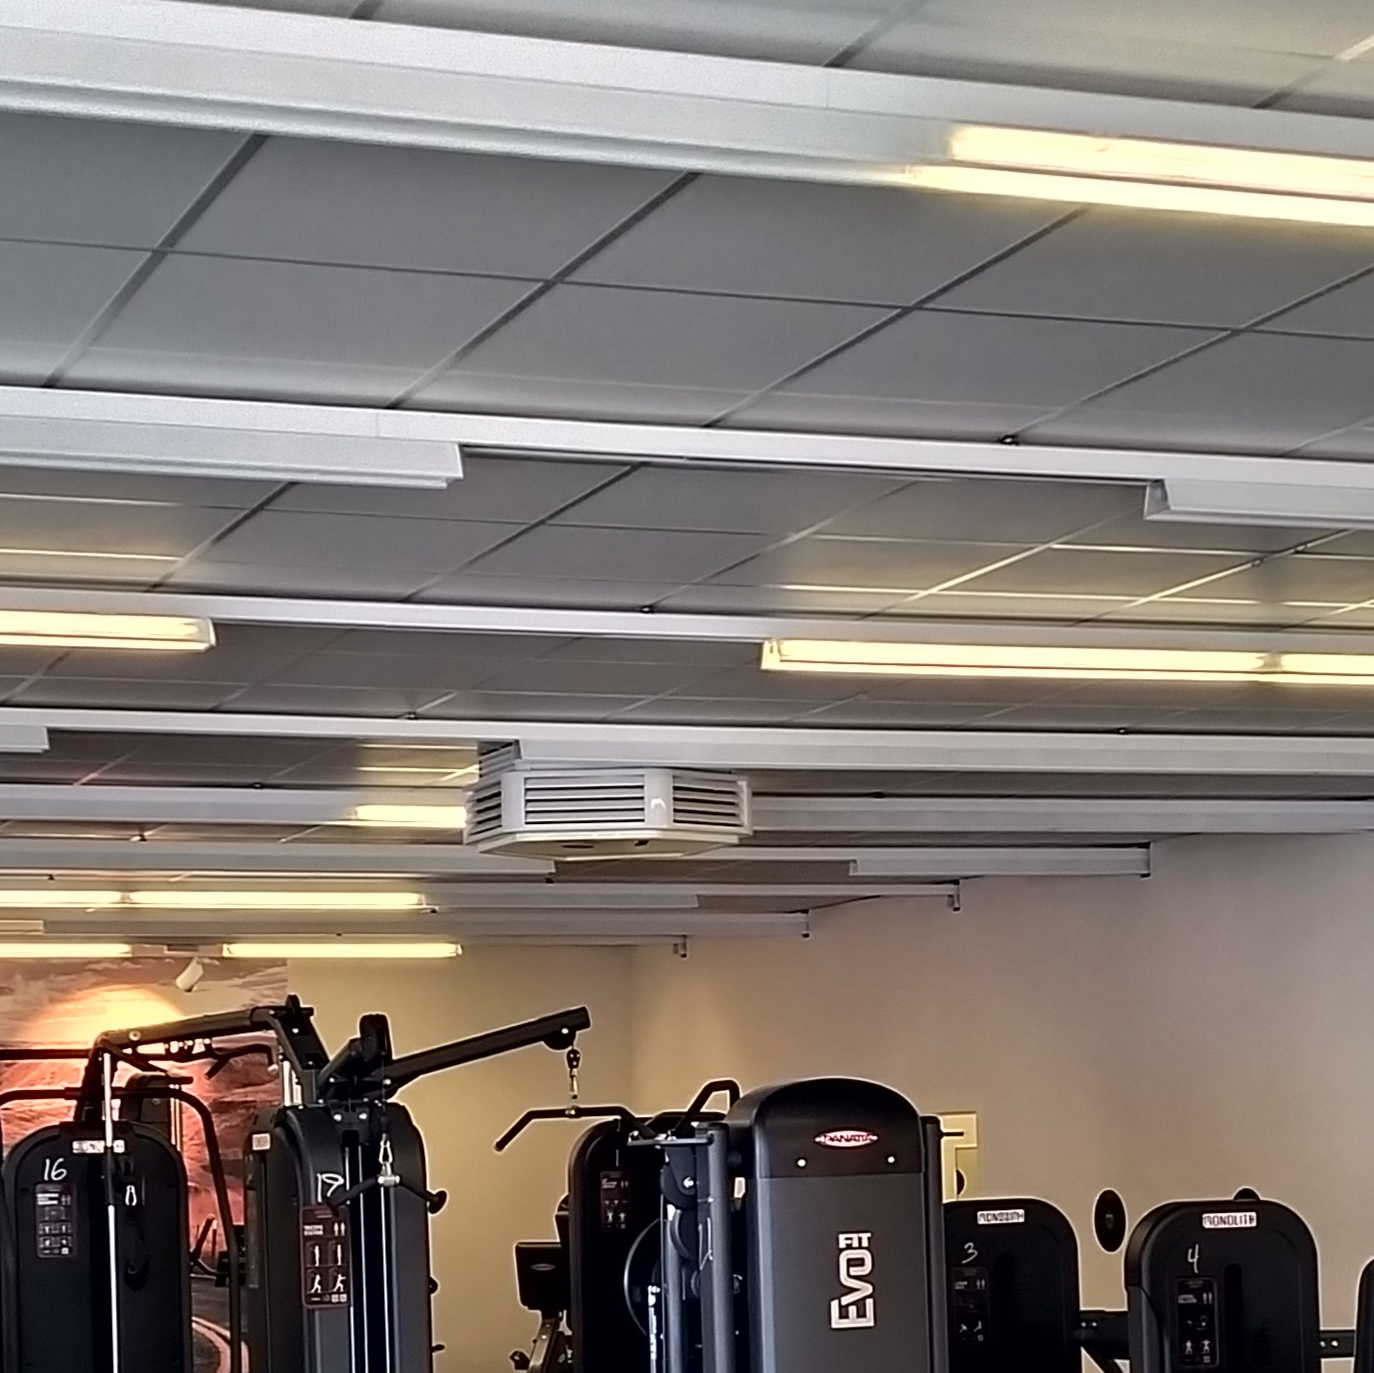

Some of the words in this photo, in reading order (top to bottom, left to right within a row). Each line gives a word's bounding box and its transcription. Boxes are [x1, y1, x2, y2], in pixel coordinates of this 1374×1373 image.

[43, 1157, 67, 1181] 16
[838, 1232, 872, 1249] FIT
[961, 1242, 978, 1263] 3
[1187, 1244, 1199, 1273] 4
[830, 1248, 875, 1328] EVO
